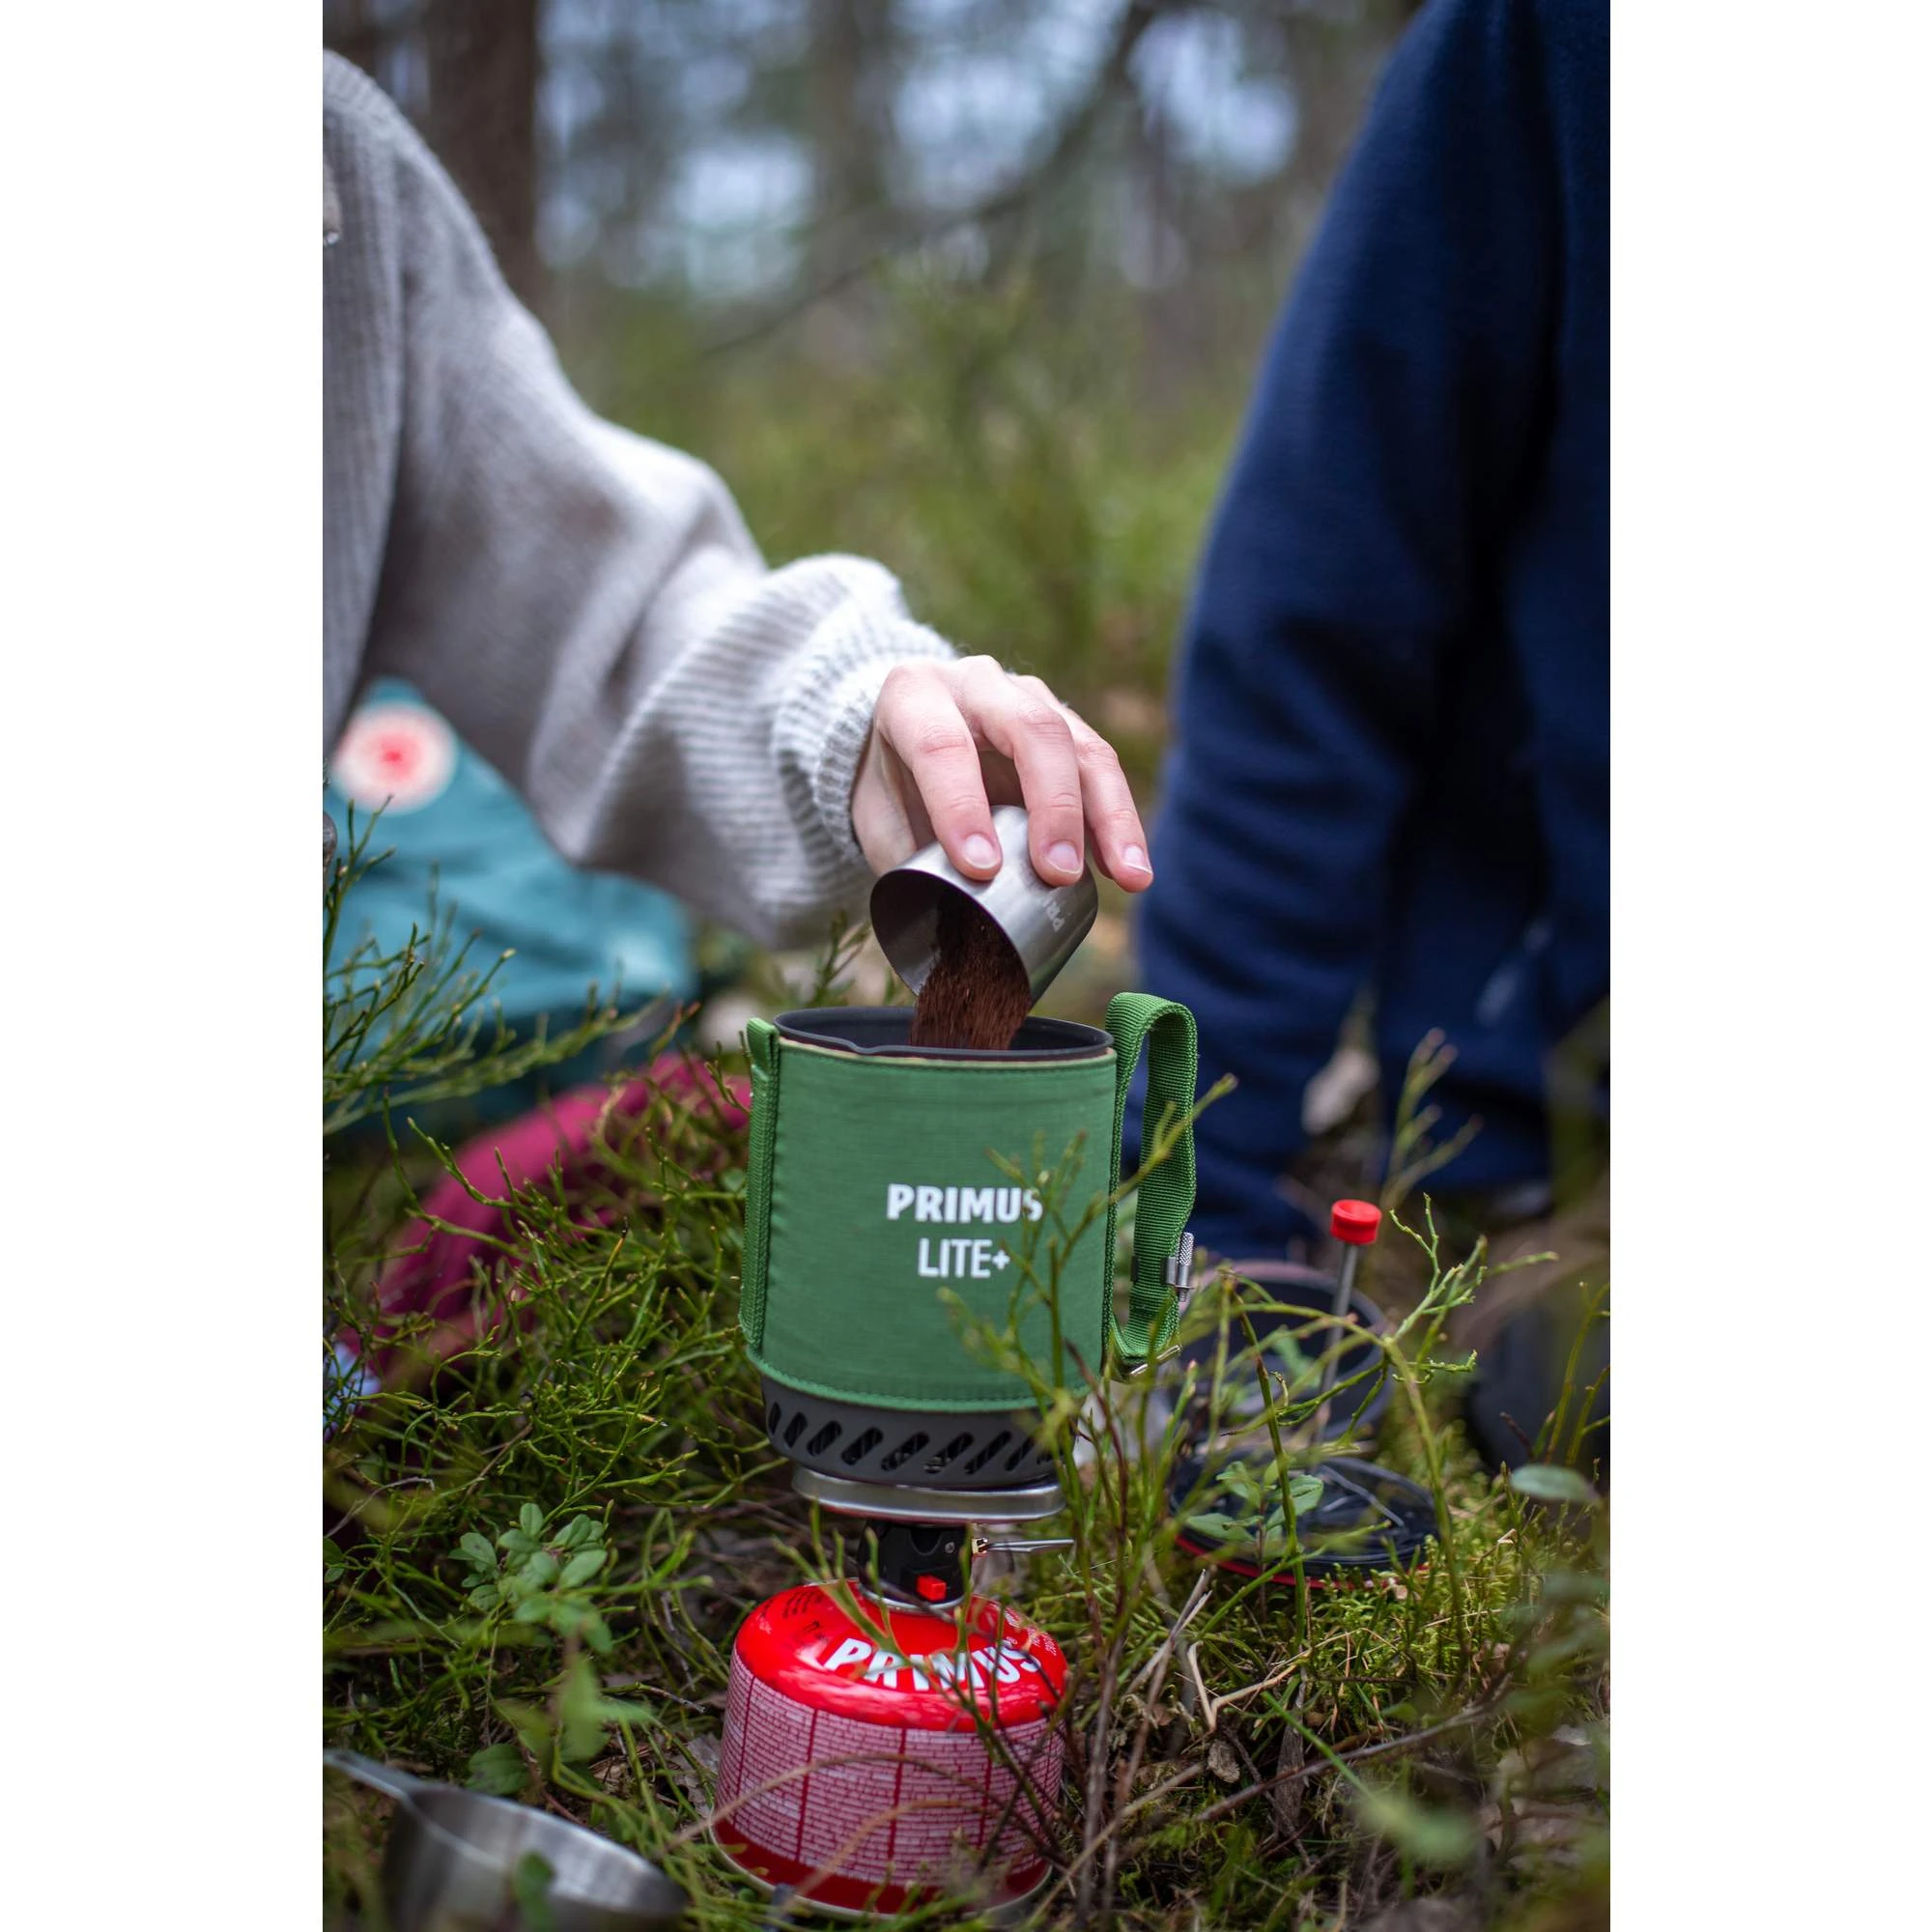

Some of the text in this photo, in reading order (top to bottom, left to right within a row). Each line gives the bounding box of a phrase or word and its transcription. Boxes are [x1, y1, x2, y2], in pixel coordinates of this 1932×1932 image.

[887, 1183, 1043, 1224] PRIMUS
[919, 1237, 1011, 1279] LITE+
[823, 1637, 1041, 1690] PRIMUS
